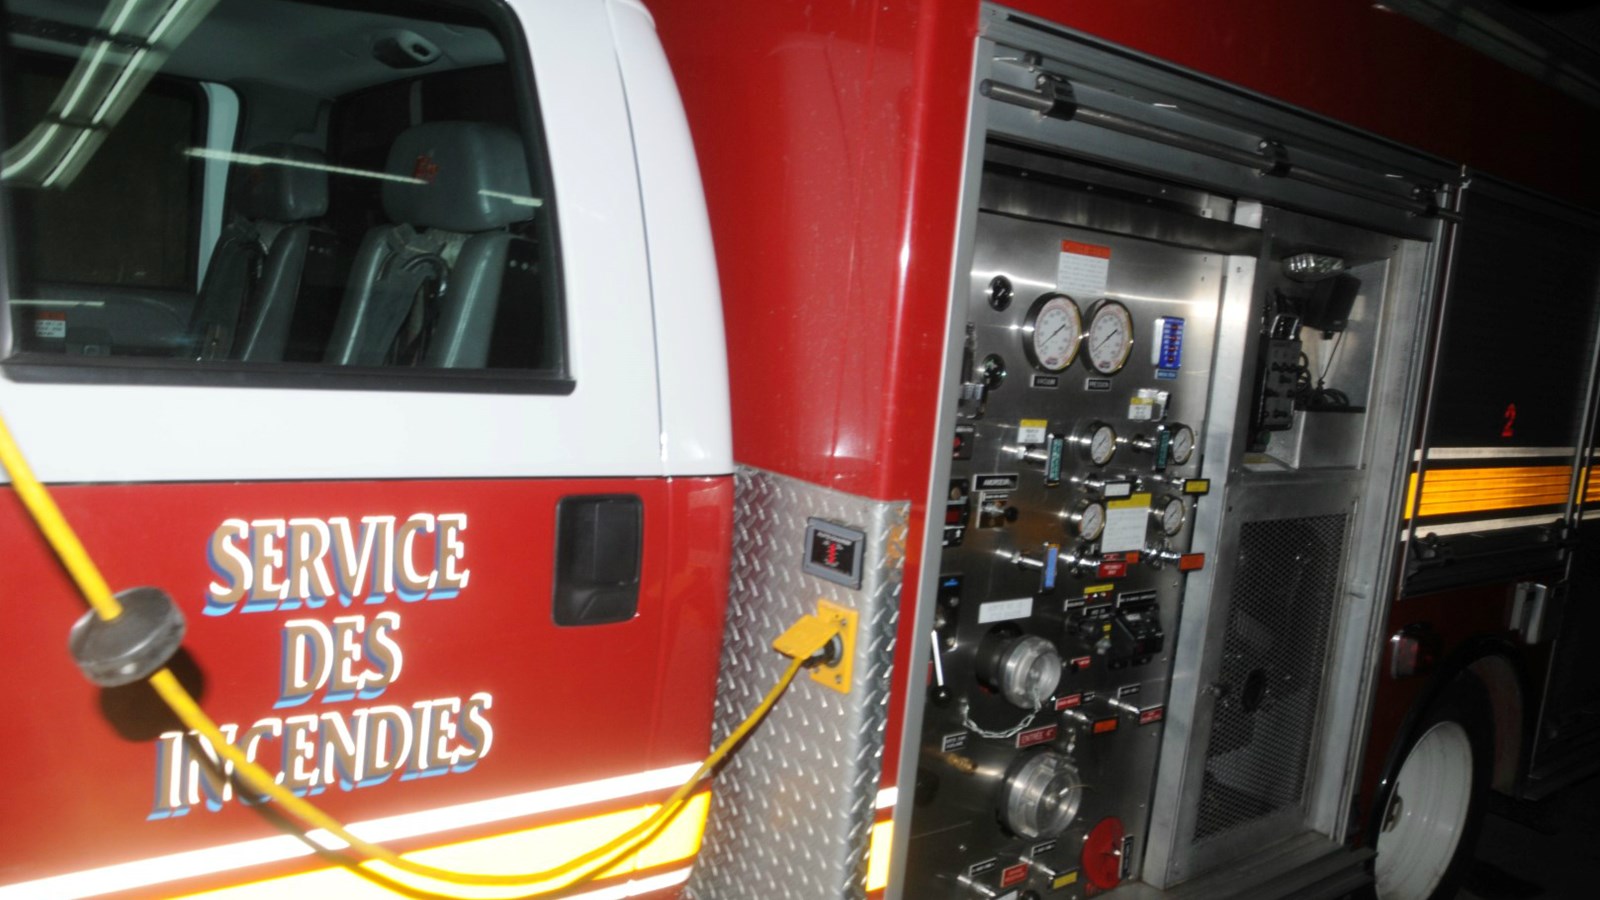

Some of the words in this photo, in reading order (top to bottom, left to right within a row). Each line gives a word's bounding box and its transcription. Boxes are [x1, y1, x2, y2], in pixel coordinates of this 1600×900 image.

[1502, 402, 1516, 438] 2
[204, 512, 470, 616] SERVICE
[273, 611, 404, 709] DES
[146, 692, 494, 821] INCENDIES
